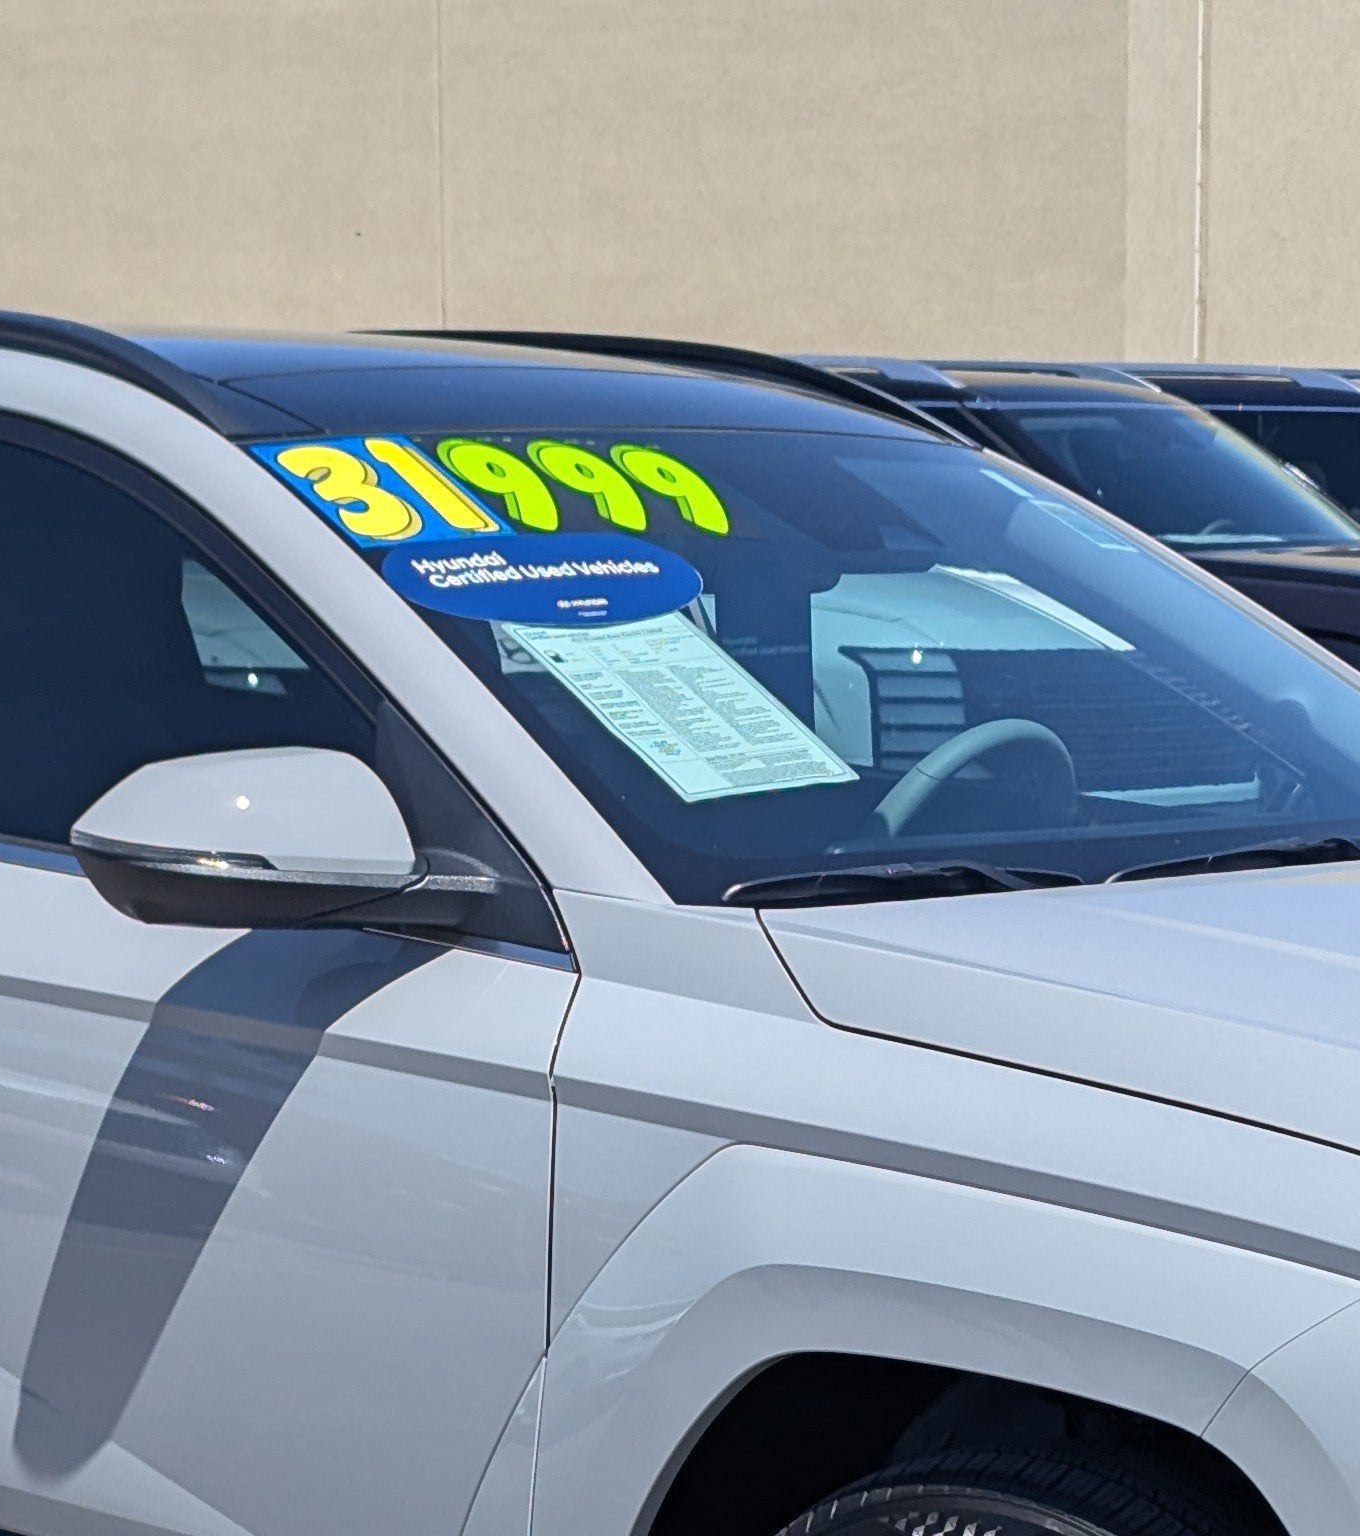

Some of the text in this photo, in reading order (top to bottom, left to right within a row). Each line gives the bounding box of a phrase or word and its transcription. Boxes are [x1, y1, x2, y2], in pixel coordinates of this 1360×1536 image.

[277, 437, 731, 537] 31999
[410, 550, 507, 574] Hyundai
[429, 559, 660, 588] Certified Used Vehicles
